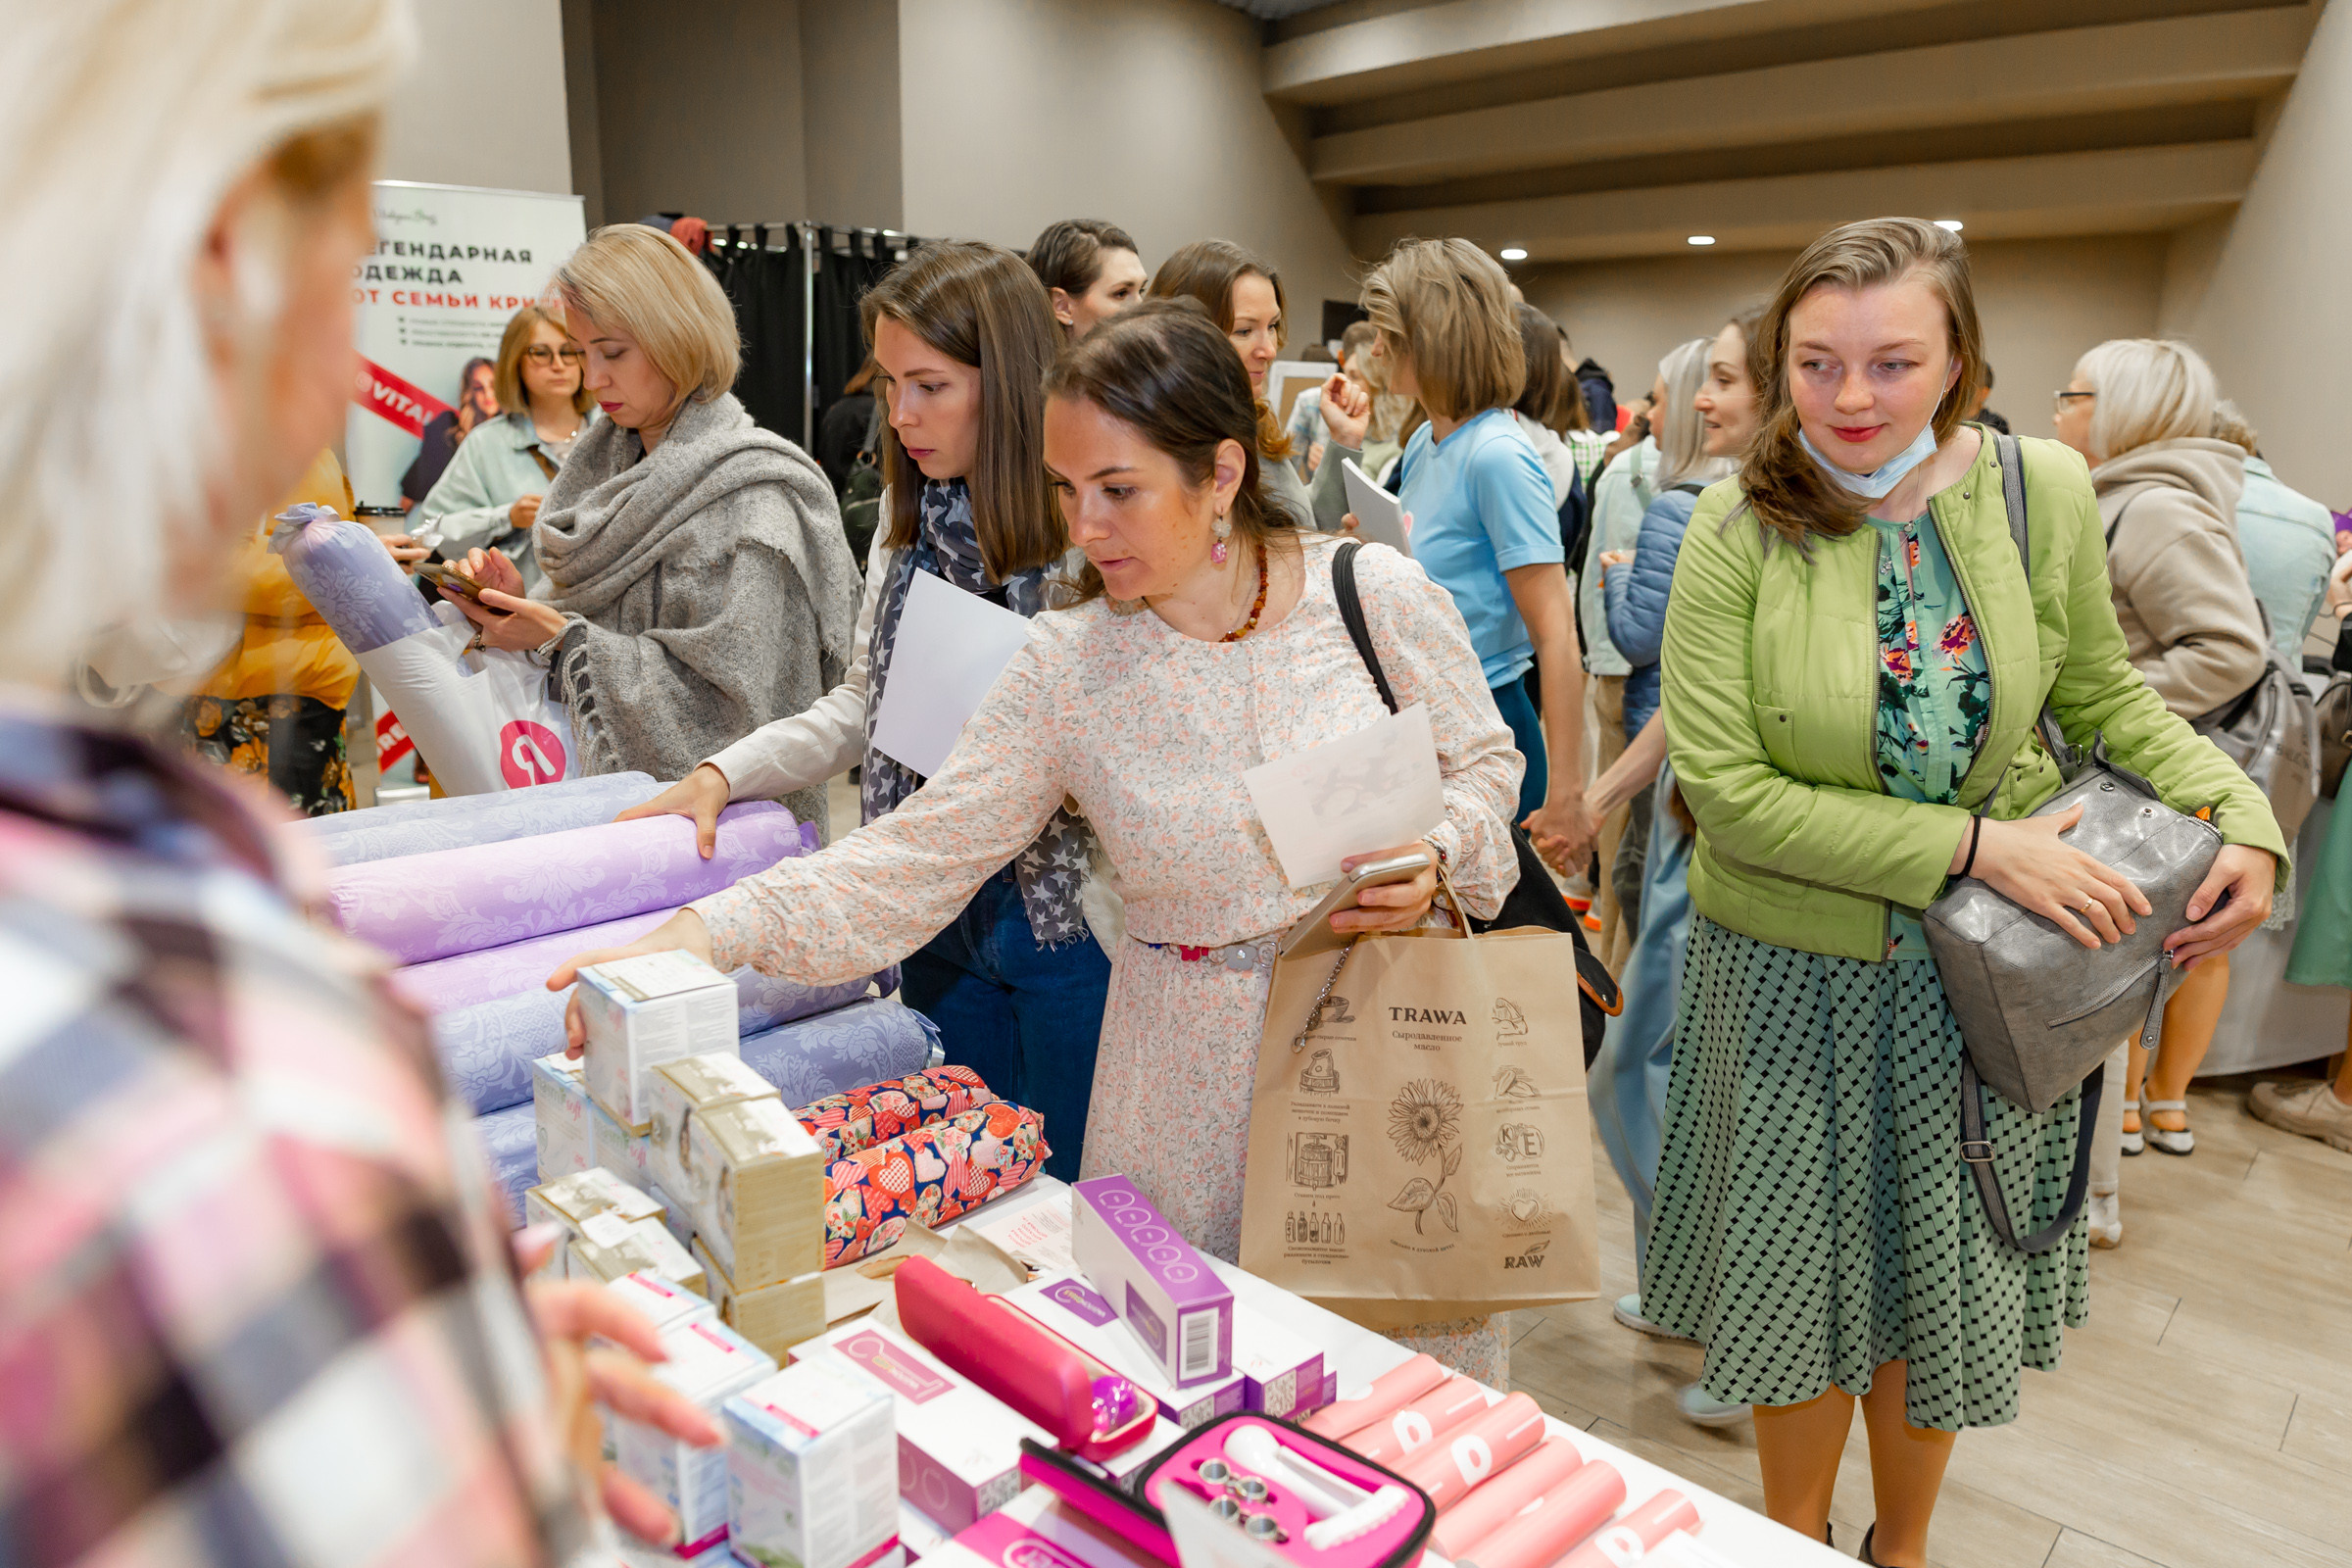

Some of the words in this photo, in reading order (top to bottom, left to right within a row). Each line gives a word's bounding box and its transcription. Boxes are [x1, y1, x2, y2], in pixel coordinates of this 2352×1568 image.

[368, 240, 531, 263] ГЕНДАРНАЯ
[352, 265, 462, 284] ОДЕЖДА
[353, 288, 379, 304] ОТ
[392, 290, 478, 308] СЕМЬИ
[1388, 1006, 1467, 1025] TRAWA
[1392, 1030, 1463, 1043] Сыродавленное
[1413, 1043, 1441, 1052] масло
[1524, 1133, 1537, 1155] E
[1503, 1254, 1544, 1269] RAW
